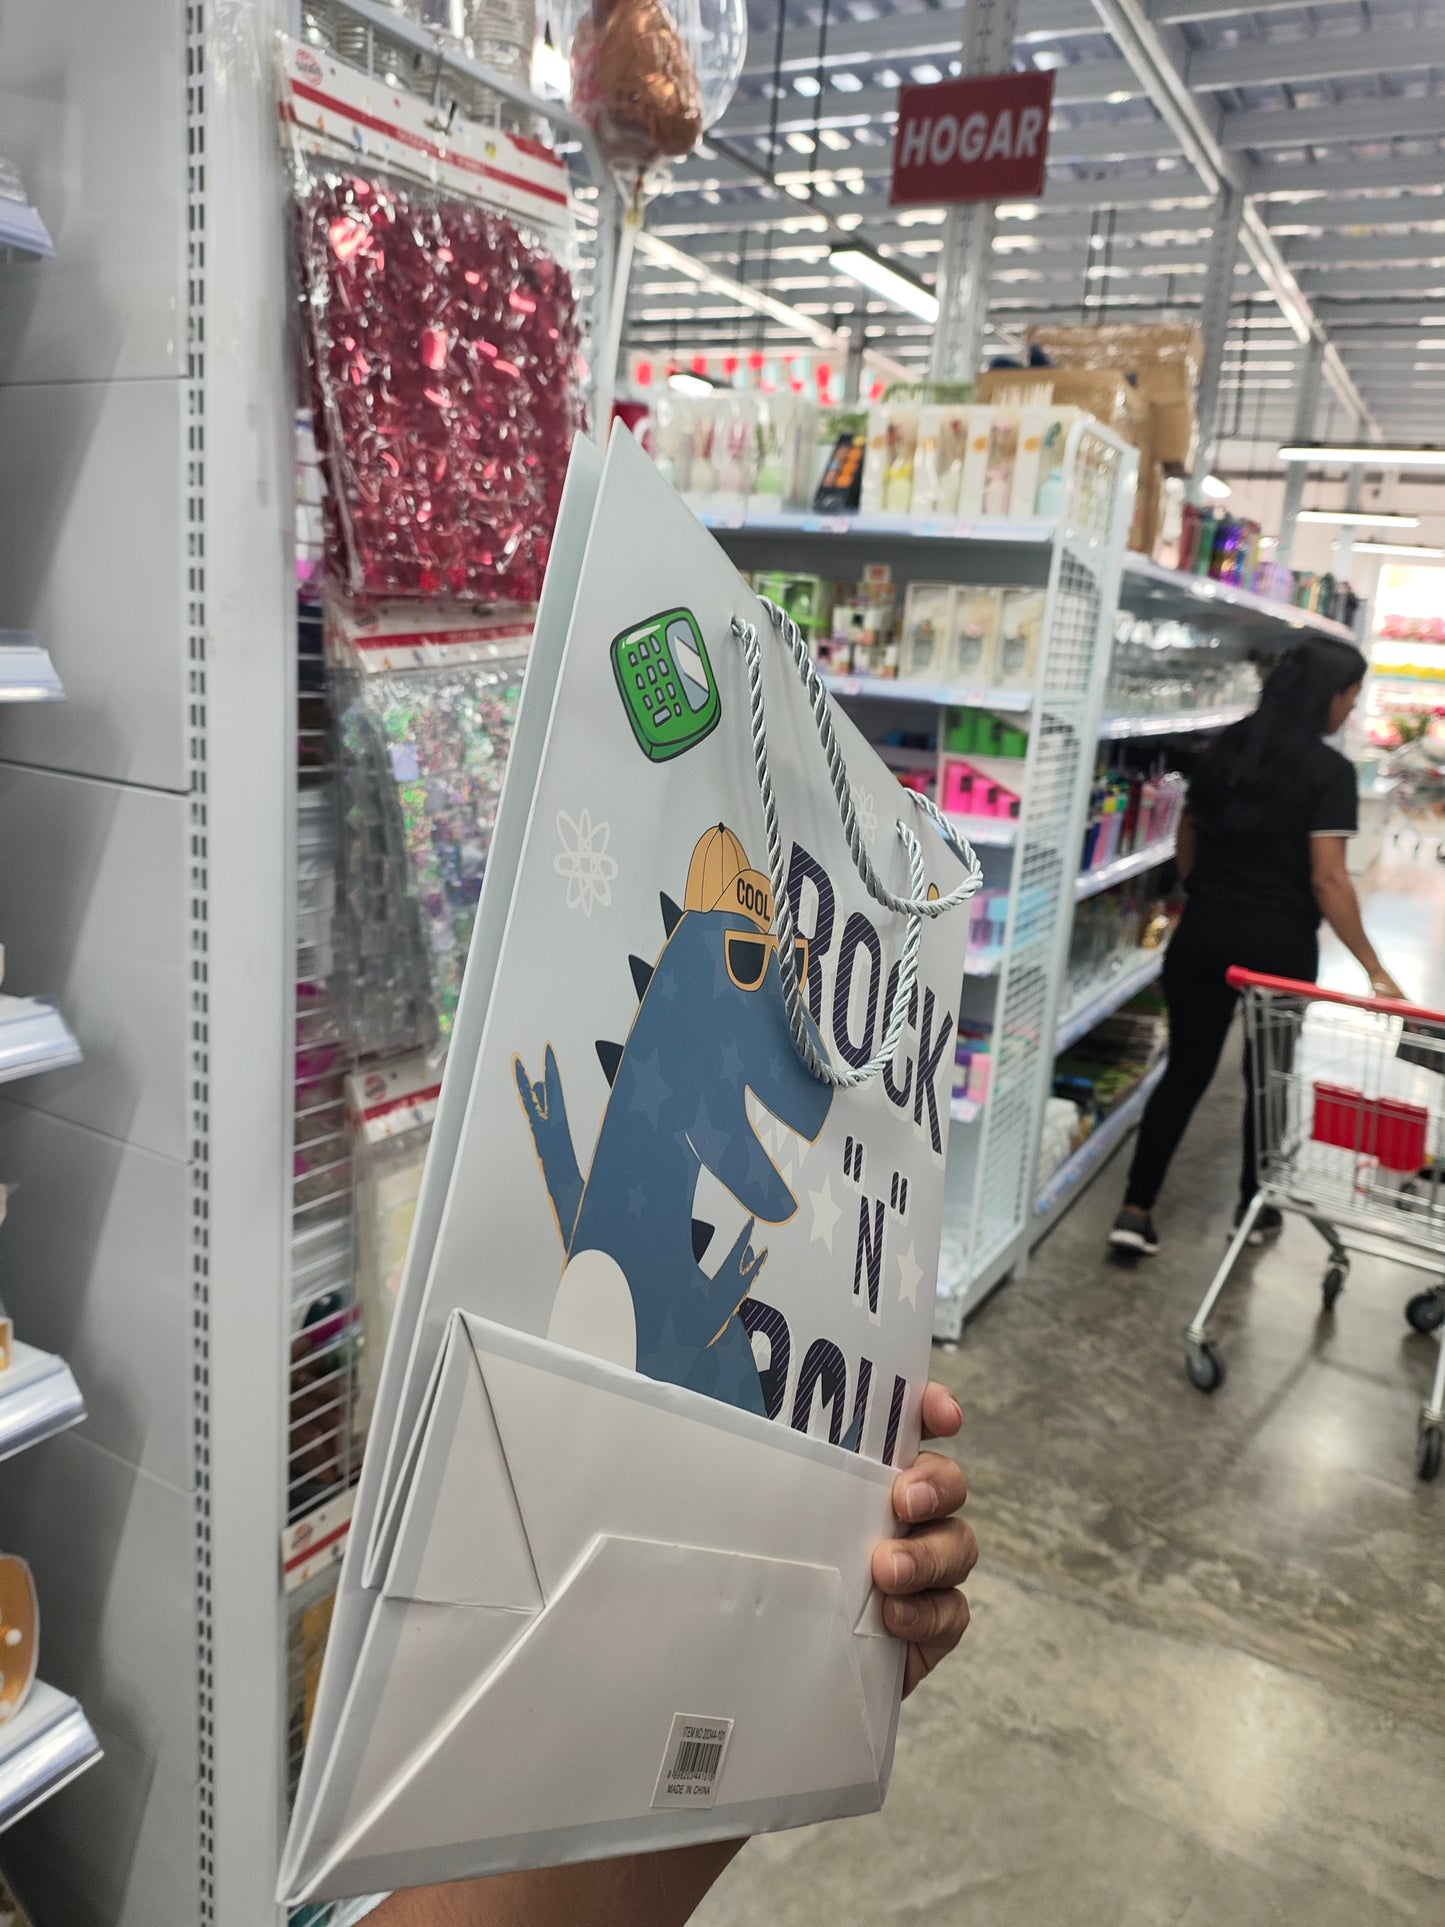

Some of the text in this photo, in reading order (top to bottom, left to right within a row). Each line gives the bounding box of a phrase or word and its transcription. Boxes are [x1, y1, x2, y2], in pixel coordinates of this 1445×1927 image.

[901, 106, 1044, 168] HOGAR
[737, 877, 770, 921] COOL
[786, 840, 954, 1155] ROCK
[667, 1784, 711, 1795] MADE IN CHINA
